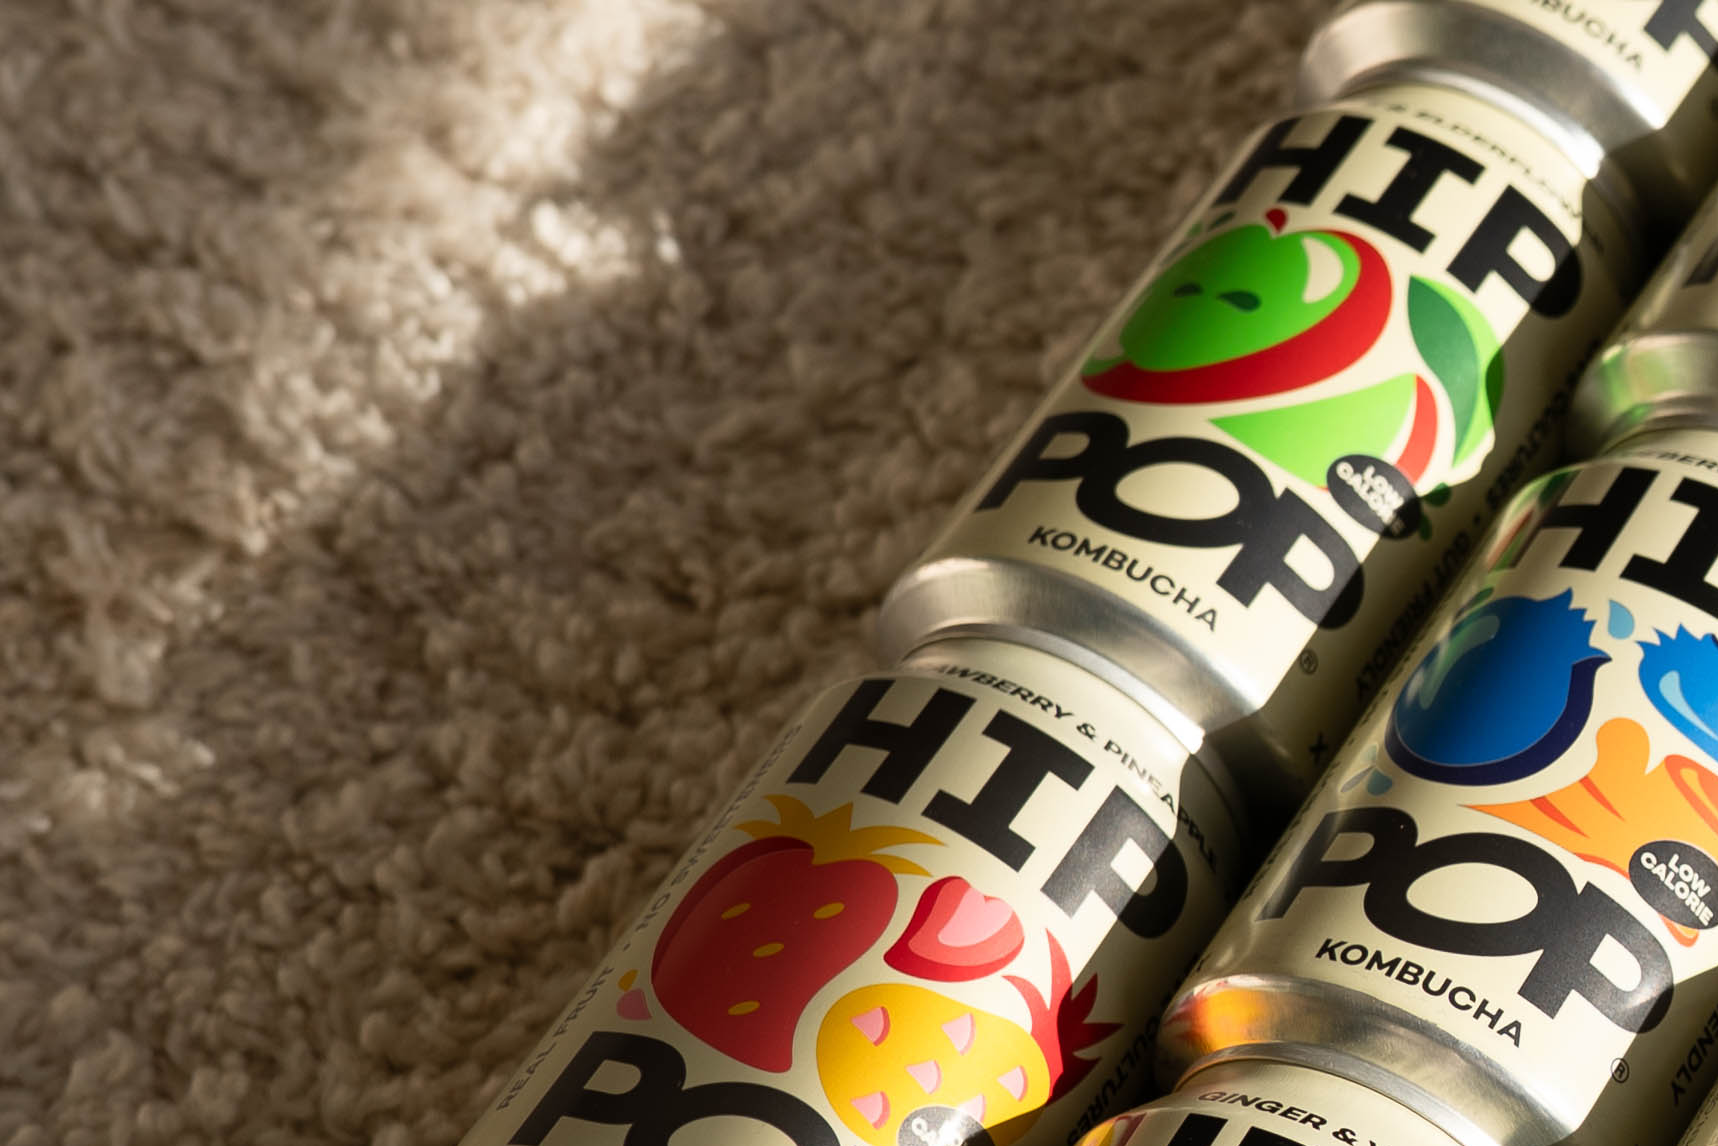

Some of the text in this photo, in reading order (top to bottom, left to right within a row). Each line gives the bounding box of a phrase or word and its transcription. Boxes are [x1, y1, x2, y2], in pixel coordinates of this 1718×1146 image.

[1532, 0, 1642, 71] BUCHA
[1216, 114, 1582, 319] HIP
[975, 411, 1364, 630] POP
[1028, 525, 1218, 632] KOMBUCHA
[934, 663, 1074, 720] AWBERRY
[1076, 722, 1097, 742] &
[785, 679, 1188, 939] HIP
[1254, 806, 1675, 1033] POP
[1640, 851, 1715, 927] CALORIE
[1669, 853, 1711, 897] LOW
[1315, 938, 1523, 1048] KOMBUCHA
[496, 1045, 556, 1112] REAL
[1198, 1090, 1328, 1130] GINGER
[1332, 1127, 1358, 1146] &
